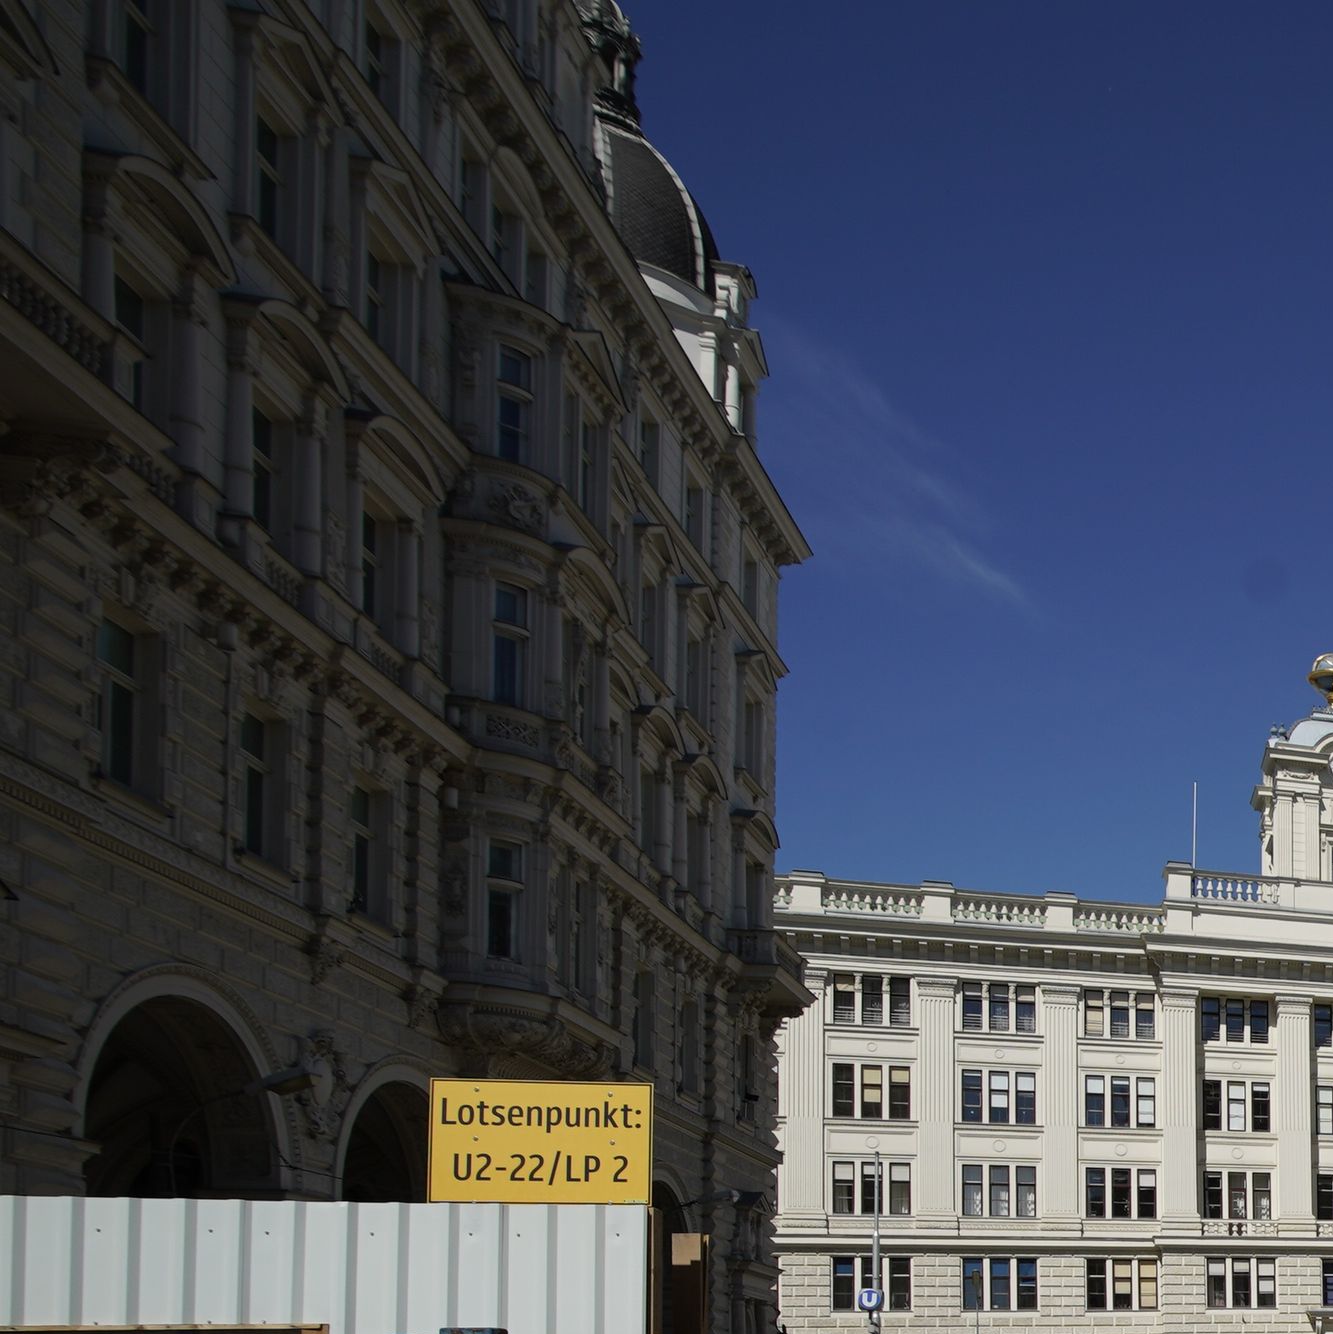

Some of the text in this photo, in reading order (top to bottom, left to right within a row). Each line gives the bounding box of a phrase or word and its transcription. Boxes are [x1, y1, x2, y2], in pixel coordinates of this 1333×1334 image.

[440, 1097, 642, 1134] Lotsenpunkt:
[453, 1150, 629, 1186] U2-22/LP 2
[862, 1292, 877, 1307] U
